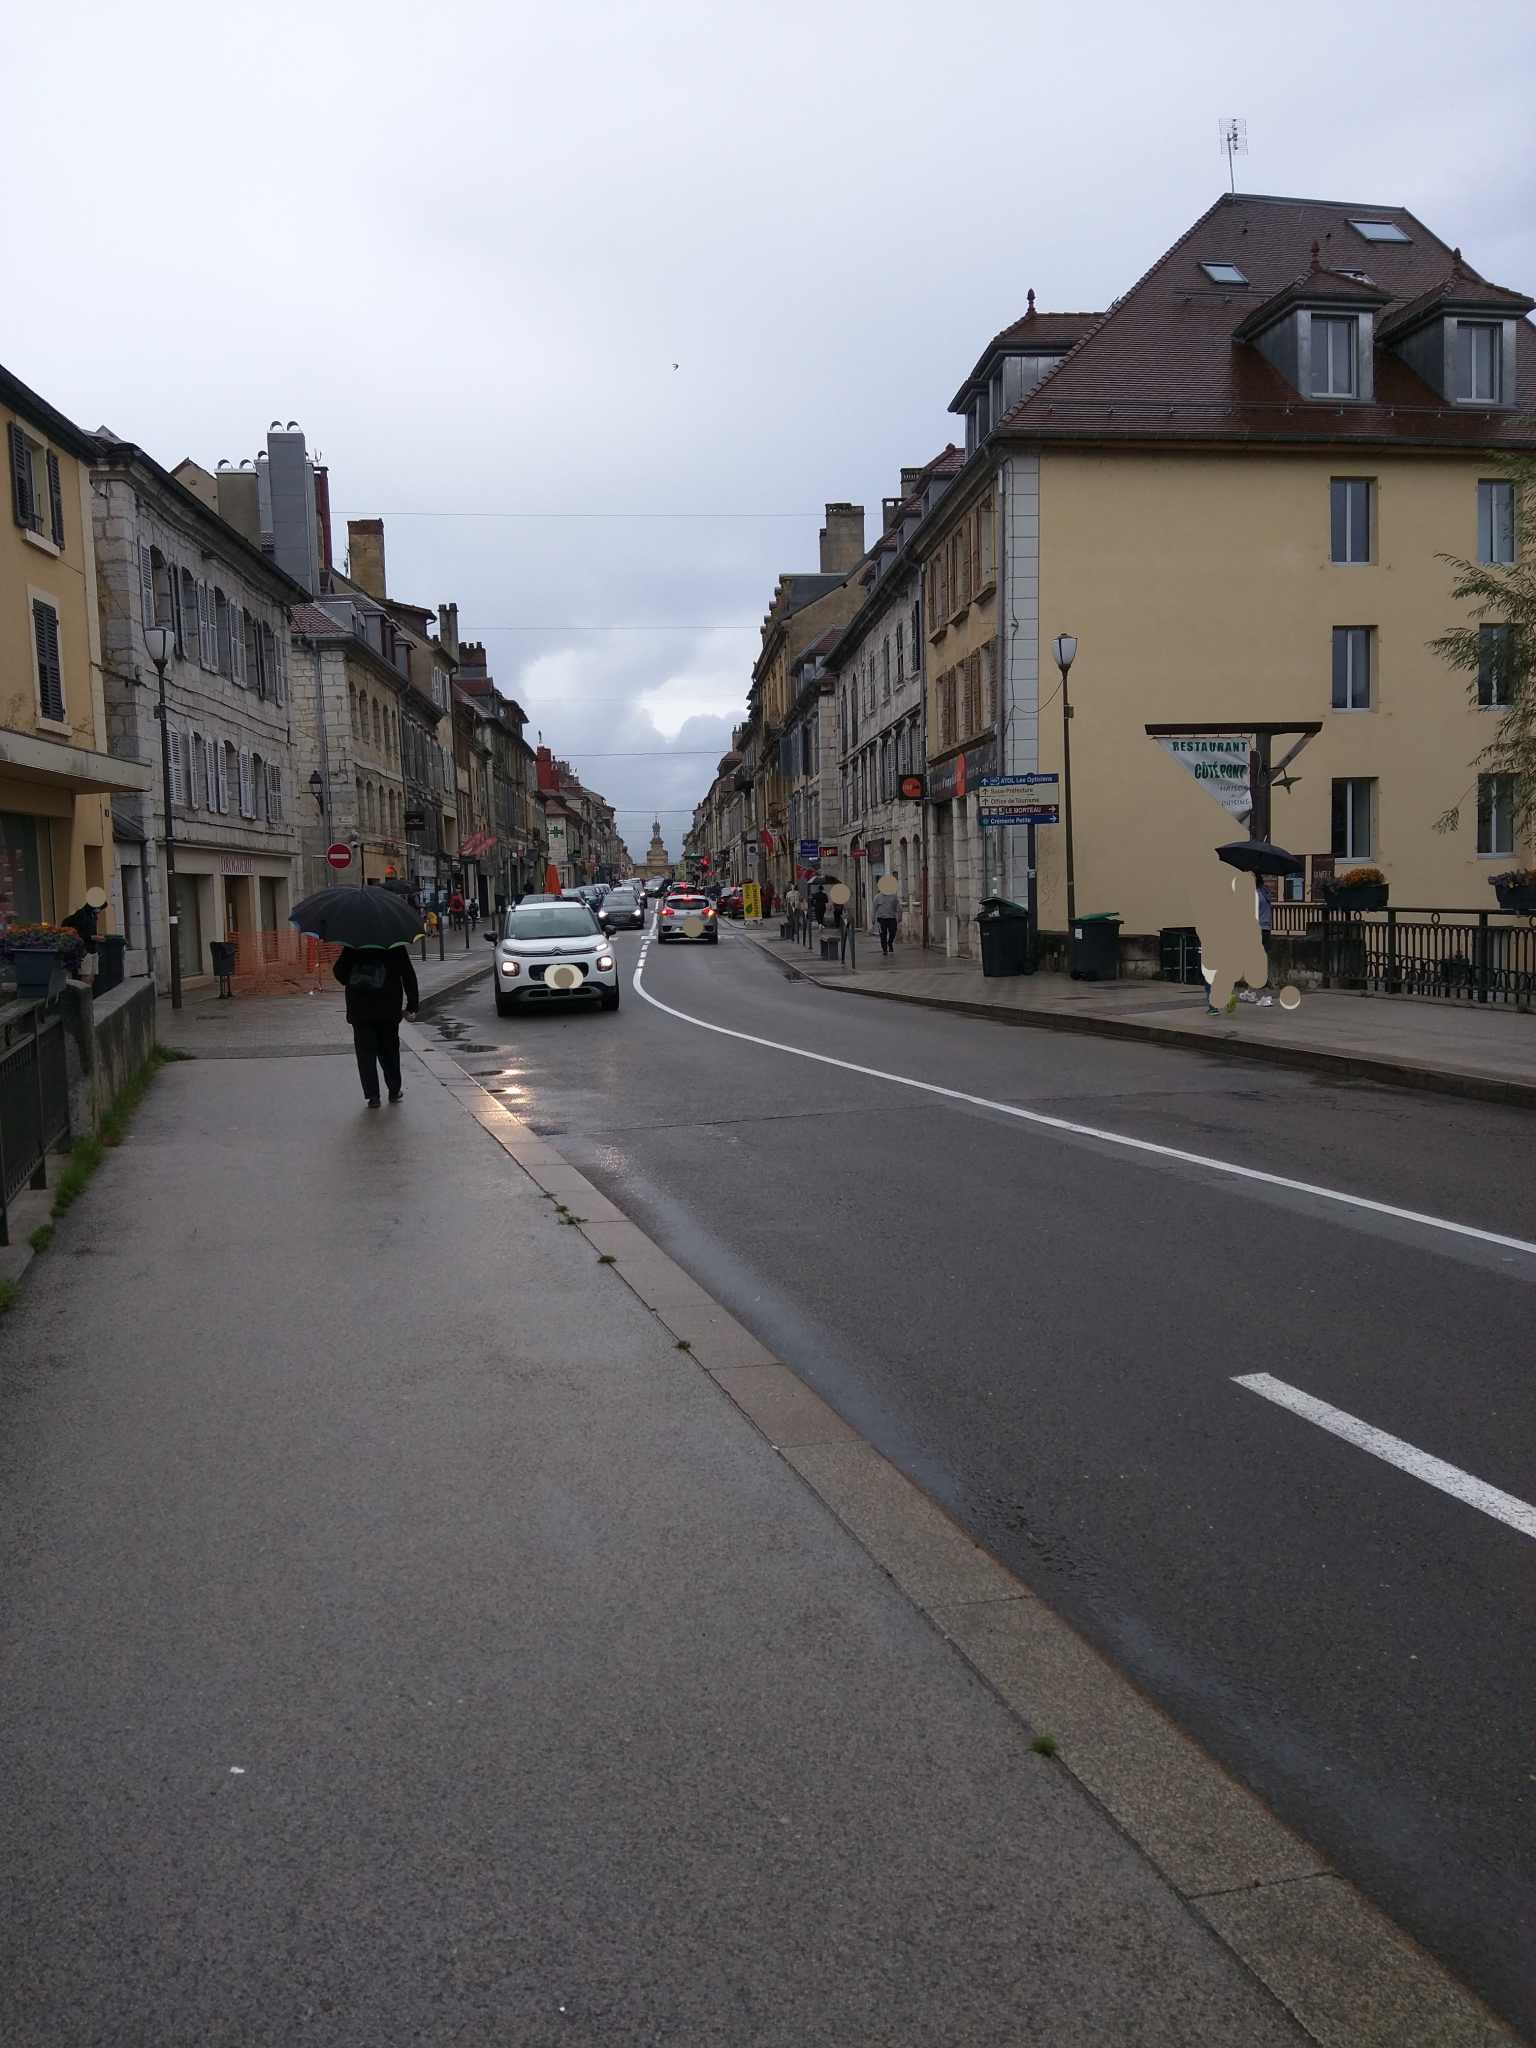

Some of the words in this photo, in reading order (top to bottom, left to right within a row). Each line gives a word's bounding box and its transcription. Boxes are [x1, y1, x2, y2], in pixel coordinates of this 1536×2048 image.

[1172, 741, 1248, 752] RESTAURANT
[1194, 761, 1220, 779] CÔTÉ
[1220, 763, 1247, 779] PONT
[1000, 777, 1015, 785] ATOL
[1027, 775, 1053, 784] Opticiens
[990, 787, 1034, 795] Sous-Préfecture
[1219, 784, 1249, 793] MAISON
[1221, 798, 1250, 807] CUISINE
[1005, 807, 1013, 815] LE
[1013, 806, 1042, 814] MORTEAU
[220, 855, 254, 874] DROGUERIE
